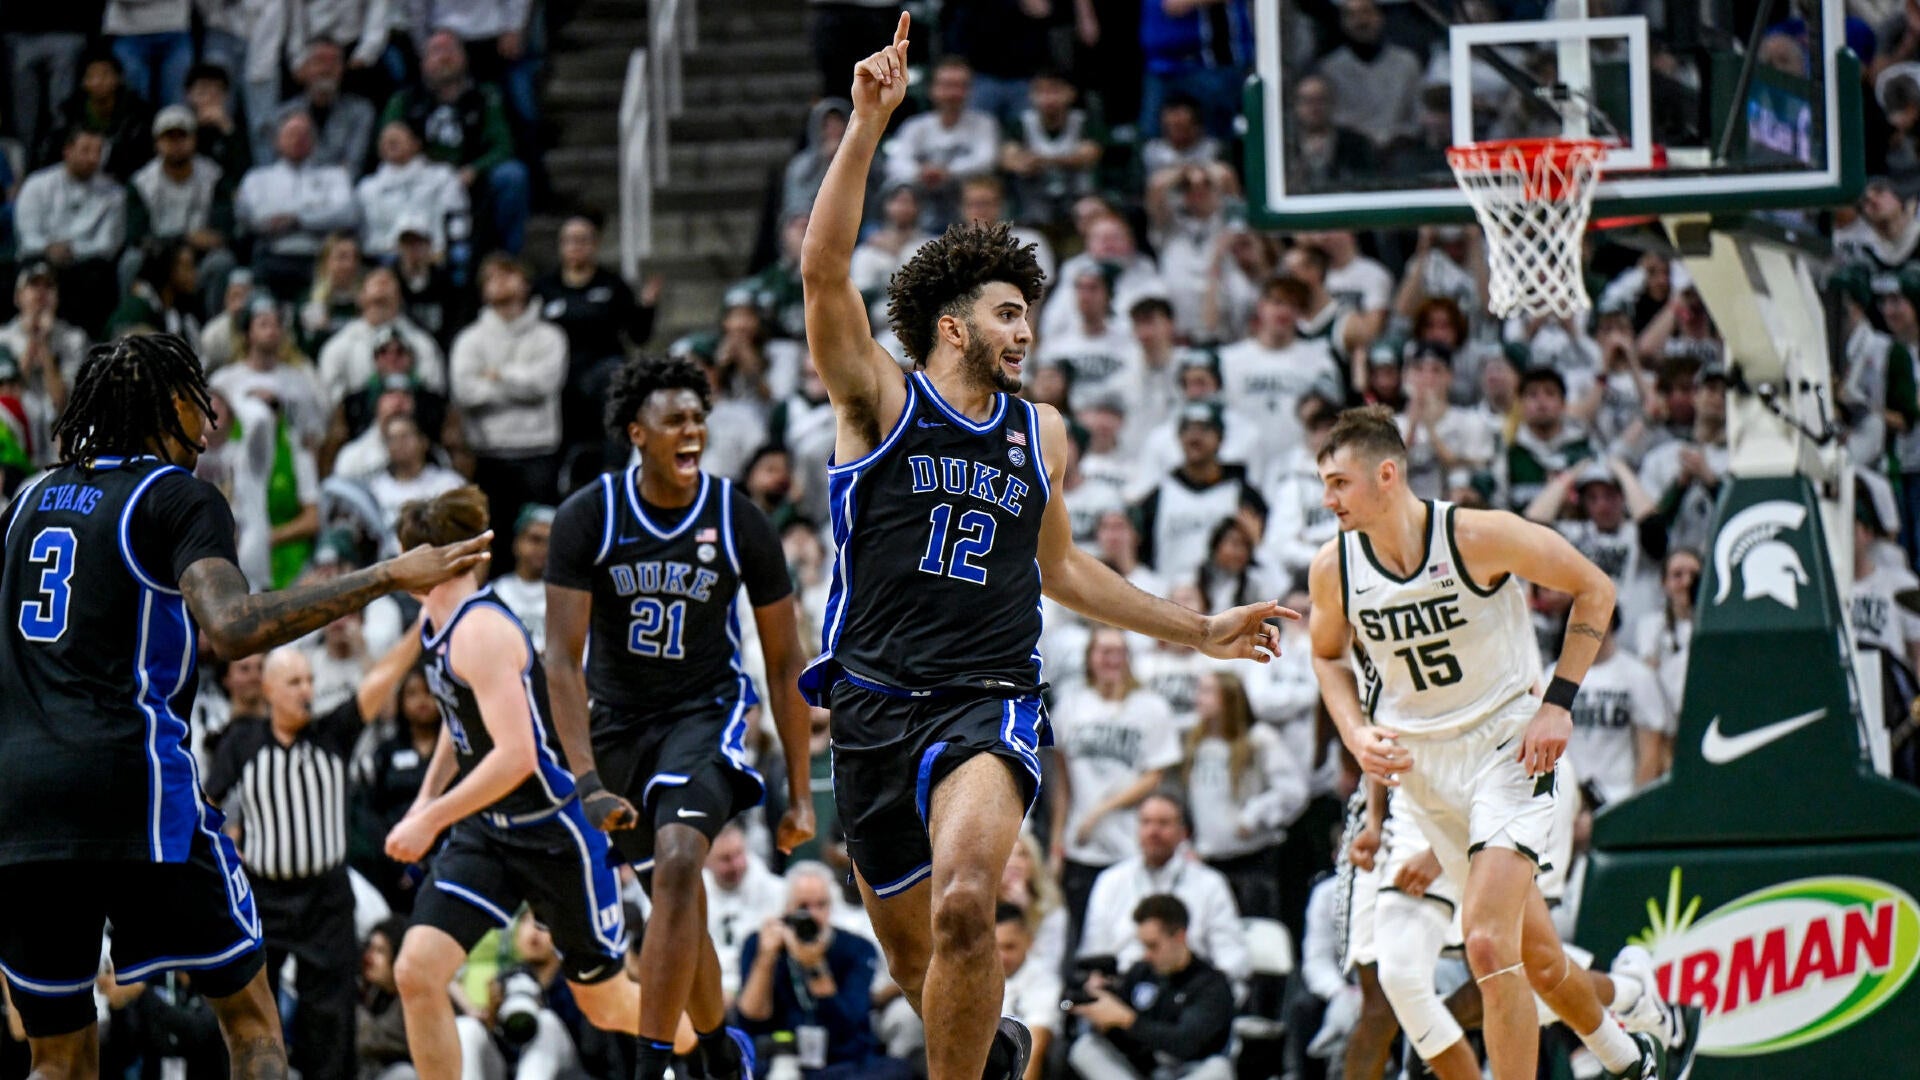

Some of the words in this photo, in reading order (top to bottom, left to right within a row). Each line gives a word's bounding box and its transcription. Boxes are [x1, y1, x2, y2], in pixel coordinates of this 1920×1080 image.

[37, 483, 104, 516] EVANS
[908, 454, 1030, 518] DUKE
[918, 502, 998, 586] 12
[18, 526, 78, 643] 3
[608, 560, 719, 603] DUKE
[627, 596, 687, 660] 21
[1358, 592, 1469, 642] STATE
[1393, 638, 1463, 692] 15
[1655, 903, 1894, 1017] IBMAN
